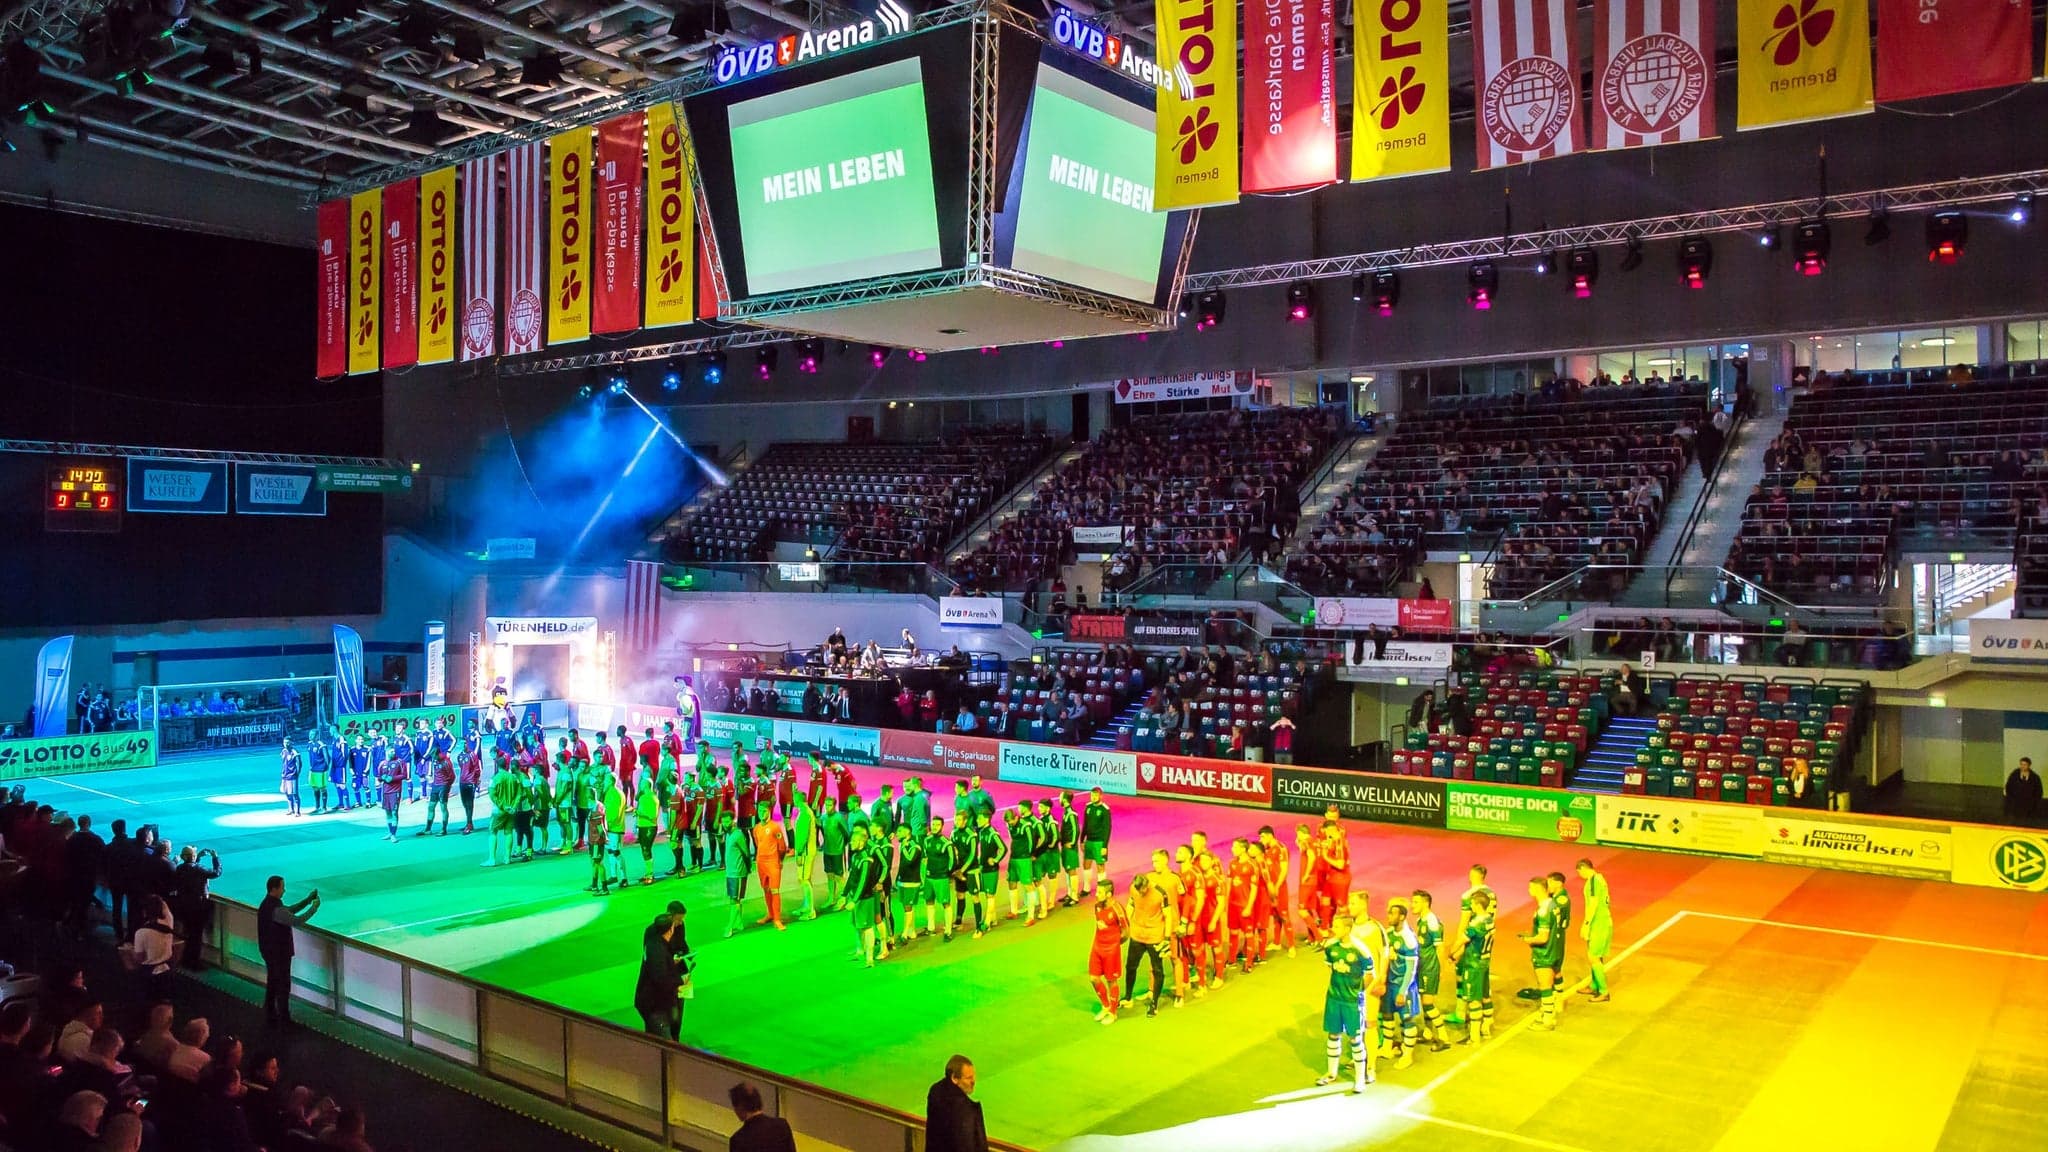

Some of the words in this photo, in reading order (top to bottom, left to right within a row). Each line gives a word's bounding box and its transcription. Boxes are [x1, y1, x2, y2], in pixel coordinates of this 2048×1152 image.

[717, 43, 774, 83] ÖVB
[798, 20, 874, 61] Arena
[1054, 8, 1104, 58] ÖVB
[1121, 45, 1173, 91] Arena
[763, 166, 822, 203] MEIN
[828, 148, 905, 190] LEBEN
[1049, 154, 1099, 195] MEIN
[1102, 171, 1154, 212] LEBEN
[1133, 390, 1156, 400] Ehre
[1166, 387, 1200, 397] Stärke
[1211, 384, 1231, 395] Mut
[150, 474, 193, 485] WESER
[254, 476, 296, 488] WESER
[149, 486, 197, 498] KURIER
[253, 488, 299, 500] KURIER
[945, 607, 962, 617] ÖVB
[968, 610, 989, 618] Arena
[496, 620, 585, 633] TÜRENHELD.de
[1134, 625, 1146, 634] AUF
[1146, 626, 1156, 635] EIN
[1157, 626, 1181, 635] STARKES
[1181, 626, 1200, 636] SPIEL!
[1982, 634, 2019, 650] ÖVB
[1643, 655, 1653, 668] 2
[207, 727, 220, 737] AUF
[222, 726, 233, 736] EIN
[233, 724, 261, 735] STARKES
[261, 722, 281, 733] SPIEL!
[740, 721, 756, 732] DICH
[24, 743, 86, 764] LOTTO
[90, 742, 101, 758] 6
[104, 743, 126, 754] aus
[126, 738, 150, 754] 49
[947, 749, 960, 758] Die
[961, 750, 996, 762] Sparkasse
[947, 760, 976, 770] Bremen
[1099, 757, 1128, 776] Welt
[1161, 766, 1266, 794] HAAKE-BECK
[1277, 778, 1337, 798] FLORIAN
[1353, 785, 1442, 809] WELLMANN
[1284, 799, 1322, 808] BREMER
[1449, 791, 1524, 809] ENTSCHEIDE
[1526, 798, 1558, 812] DICH
[1449, 802, 1473, 818] FÜR
[1475, 808, 1510, 822] DICH!
[1814, 830, 1865, 842] AUTOHAUS
